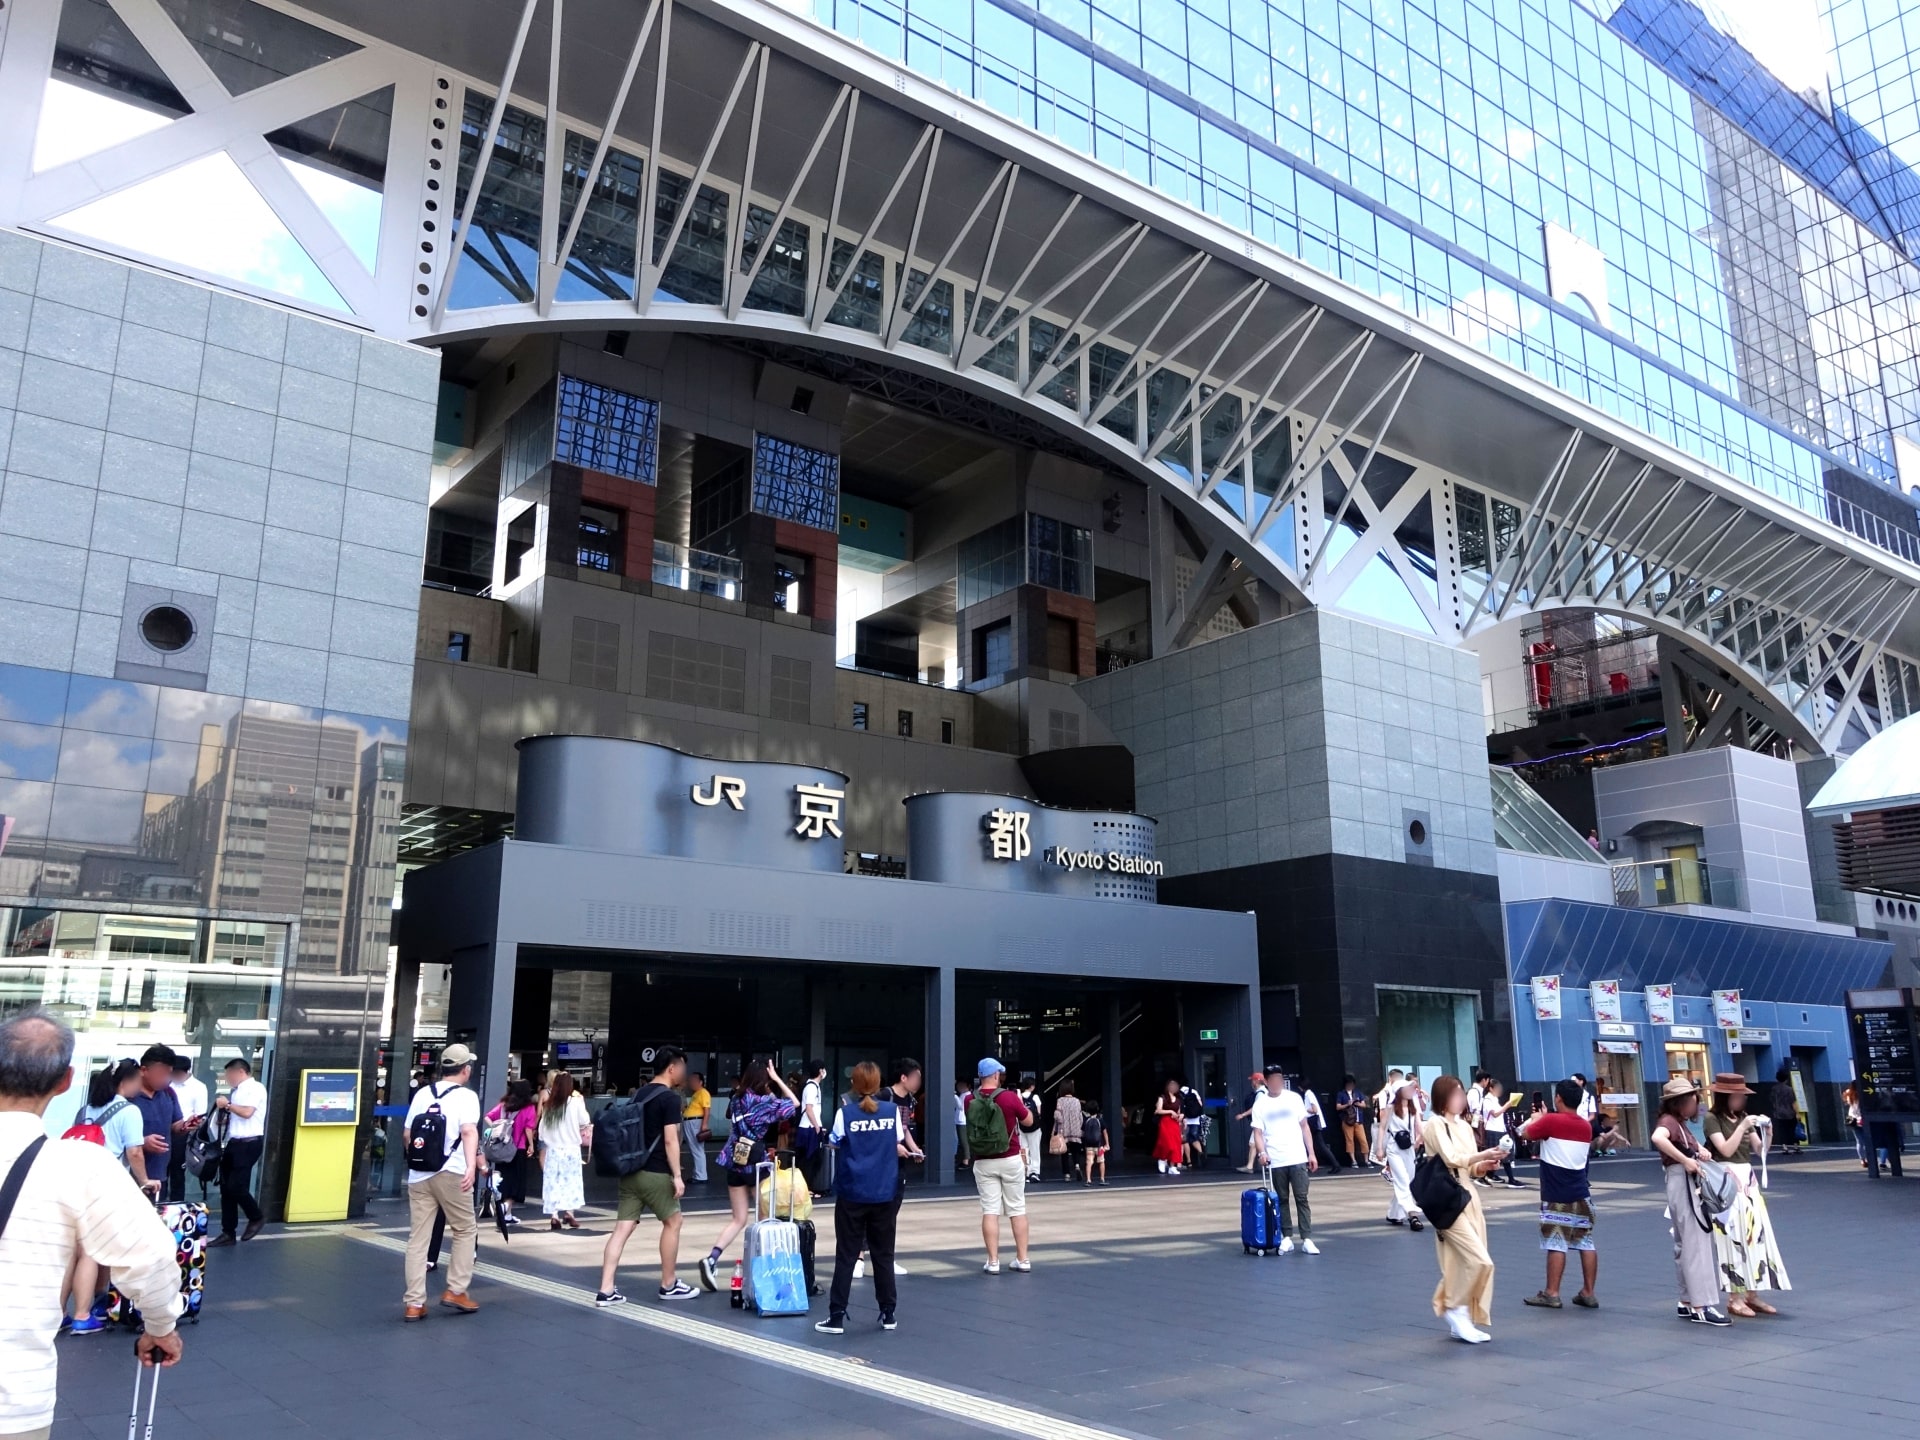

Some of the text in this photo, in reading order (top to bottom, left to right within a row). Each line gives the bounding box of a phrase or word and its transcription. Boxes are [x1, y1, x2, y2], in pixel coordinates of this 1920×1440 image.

[691, 774, 1032, 861] JR 京 都
[1056, 846, 1164, 876] Kyoto Station
[850, 1118, 895, 1132] STAFF
